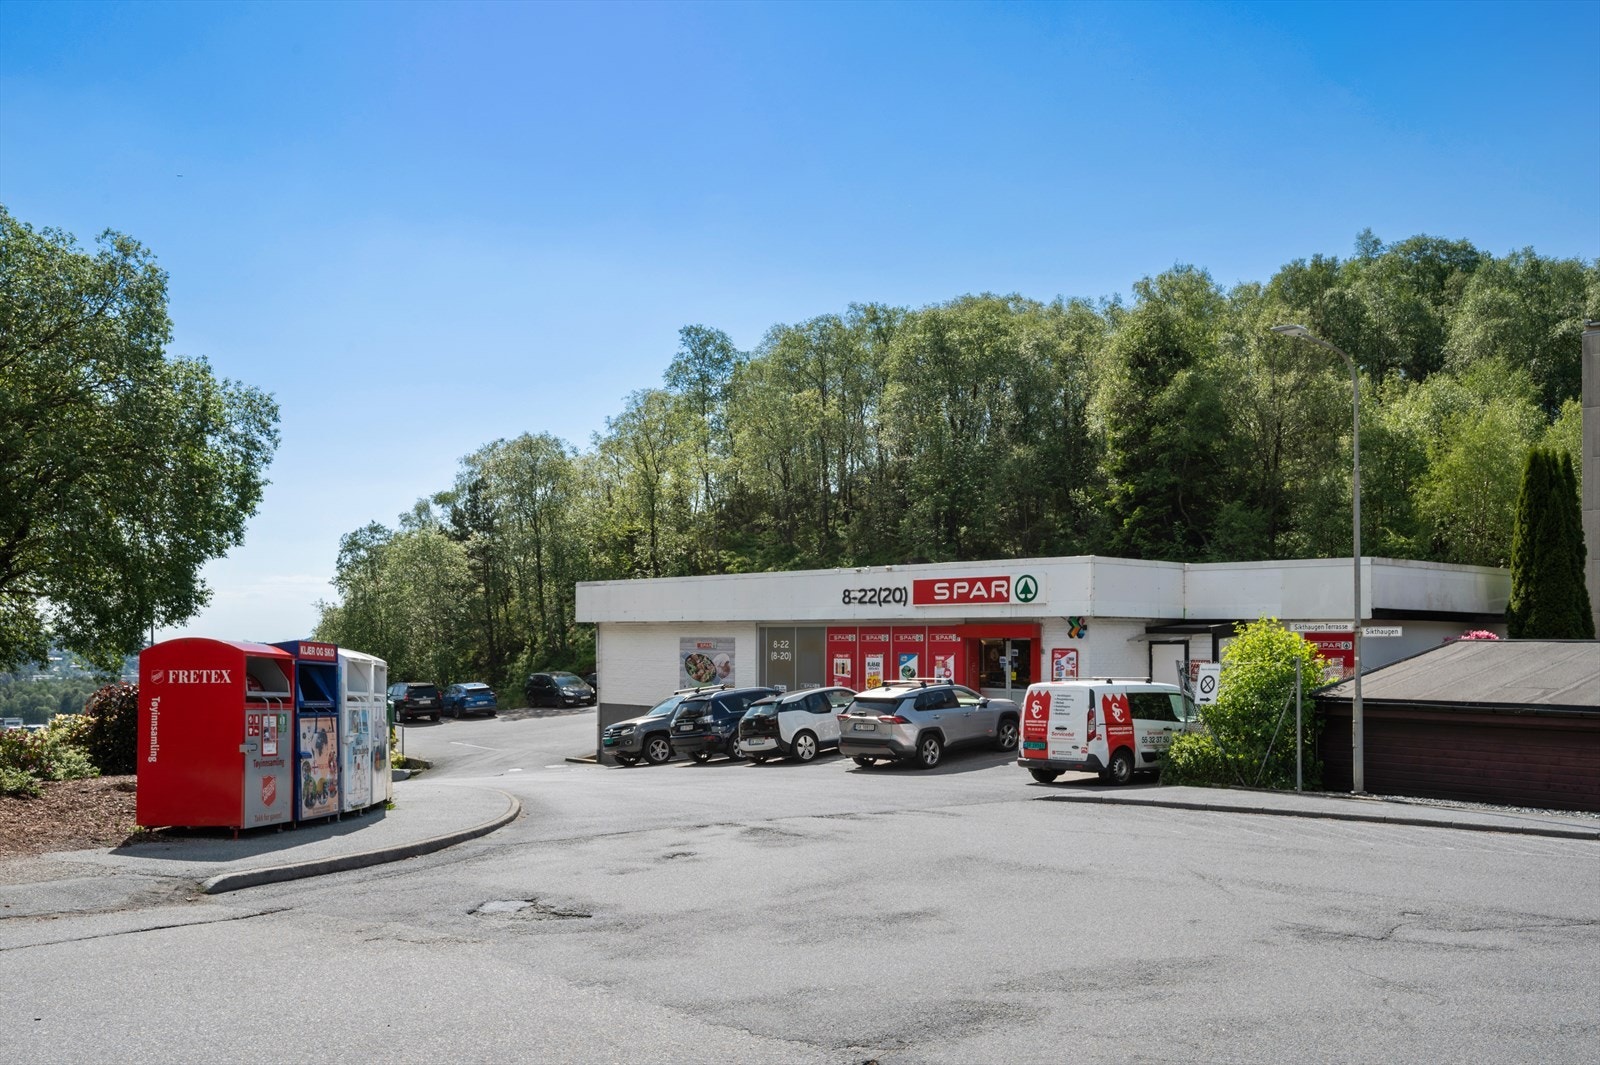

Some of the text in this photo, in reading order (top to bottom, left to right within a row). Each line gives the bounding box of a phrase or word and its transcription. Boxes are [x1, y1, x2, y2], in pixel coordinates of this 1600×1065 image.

[934, 580, 1009, 600] SPAR
[842, 586, 908, 607] 8-22(20)
[1294, 623, 1324, 632] Sikthaugen
[1365, 628, 1399, 636] Sikthaugen
[772, 640, 790, 648] 8-22
[316, 646, 324, 656] OG
[770, 652, 792, 660] (8-20)
[168, 669, 232, 684] FRETEX
[148, 696, 160, 763] Tøyinnsamling
[253, 758, 284, 768] Tøyinnsamling
